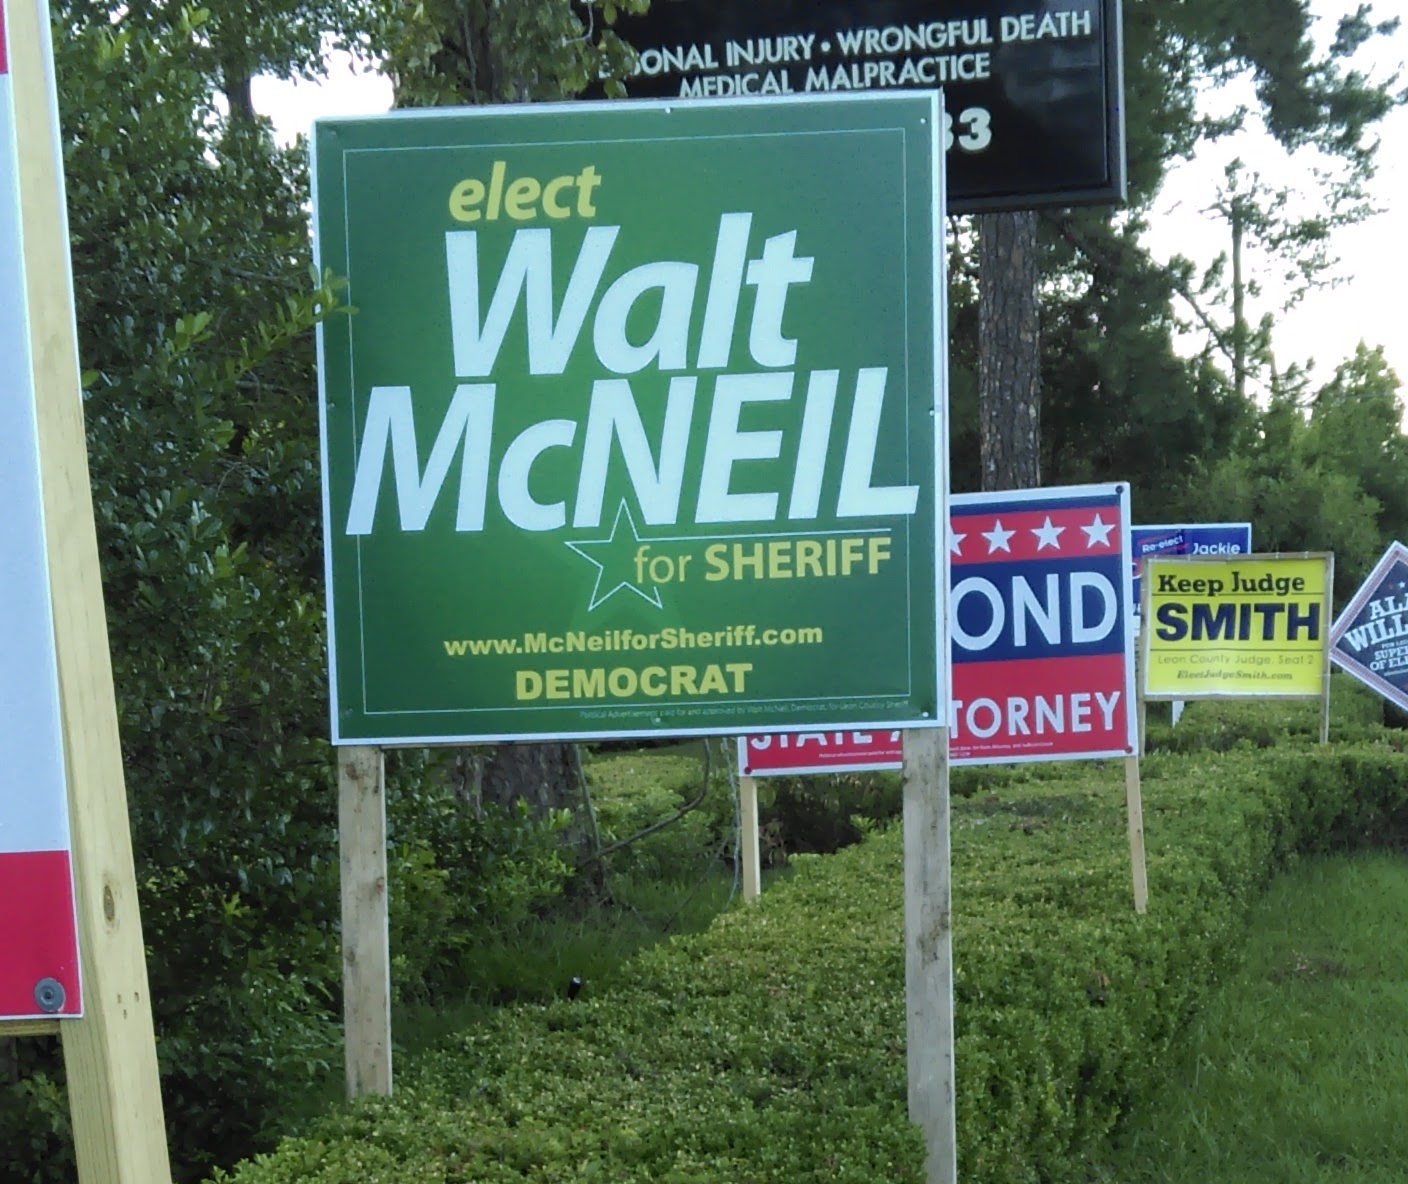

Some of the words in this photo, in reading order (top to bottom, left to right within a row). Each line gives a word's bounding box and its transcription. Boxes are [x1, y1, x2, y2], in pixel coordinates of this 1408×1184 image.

[726, 33, 815, 67] INJURY
[836, 18, 993, 56] WRONGFUL
[1001, 10, 1091, 42] DEATH
[679, 69, 795, 99] MEDICAL
[805, 52, 991, 93] MALPRACTICE
[449, 161, 602, 223] elect
[445, 211, 815, 378] Walt
[345, 367, 920, 536] McNEIL
[634, 546, 692, 584] for
[704, 537, 892, 582] SHERIFF
[1193, 542, 1241, 554] Jackie
[1158, 574, 1224, 597] Keep
[1232, 571, 1305, 596] Judge
[951, 571, 1119, 651] OND
[1156, 602, 1320, 641] SMITH
[444, 624, 823, 656] www.McNeilforSheriff.com
[1158, 654, 1186, 665] Leon
[1190, 654, 1230, 666] County
[1278, 654, 1304, 665] Seat
[1307, 654, 1314, 665] 2
[515, 663, 753, 700] DEMOCRAT
[1369, 660, 1388, 671] OF
